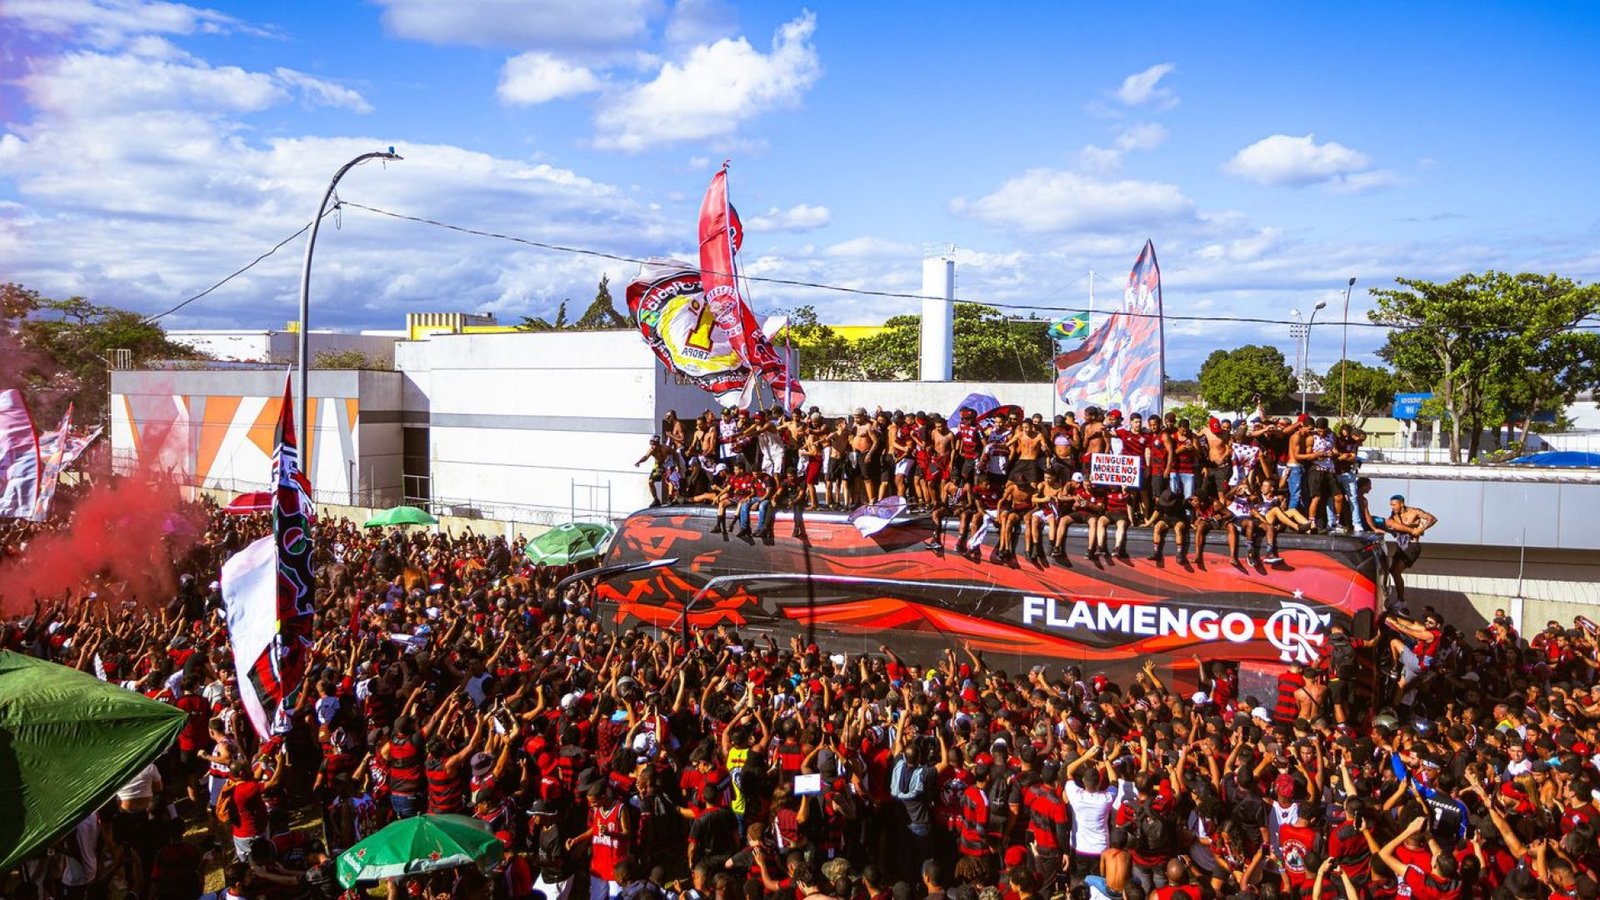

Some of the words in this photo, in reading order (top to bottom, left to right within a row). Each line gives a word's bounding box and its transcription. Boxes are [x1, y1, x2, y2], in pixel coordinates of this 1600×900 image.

[1093, 464, 1121, 474] MORRE
[1122, 466, 1137, 476] NOS
[1094, 473, 1136, 485] DEVENDO!
[1022, 596, 1254, 643] FLAMENGO
